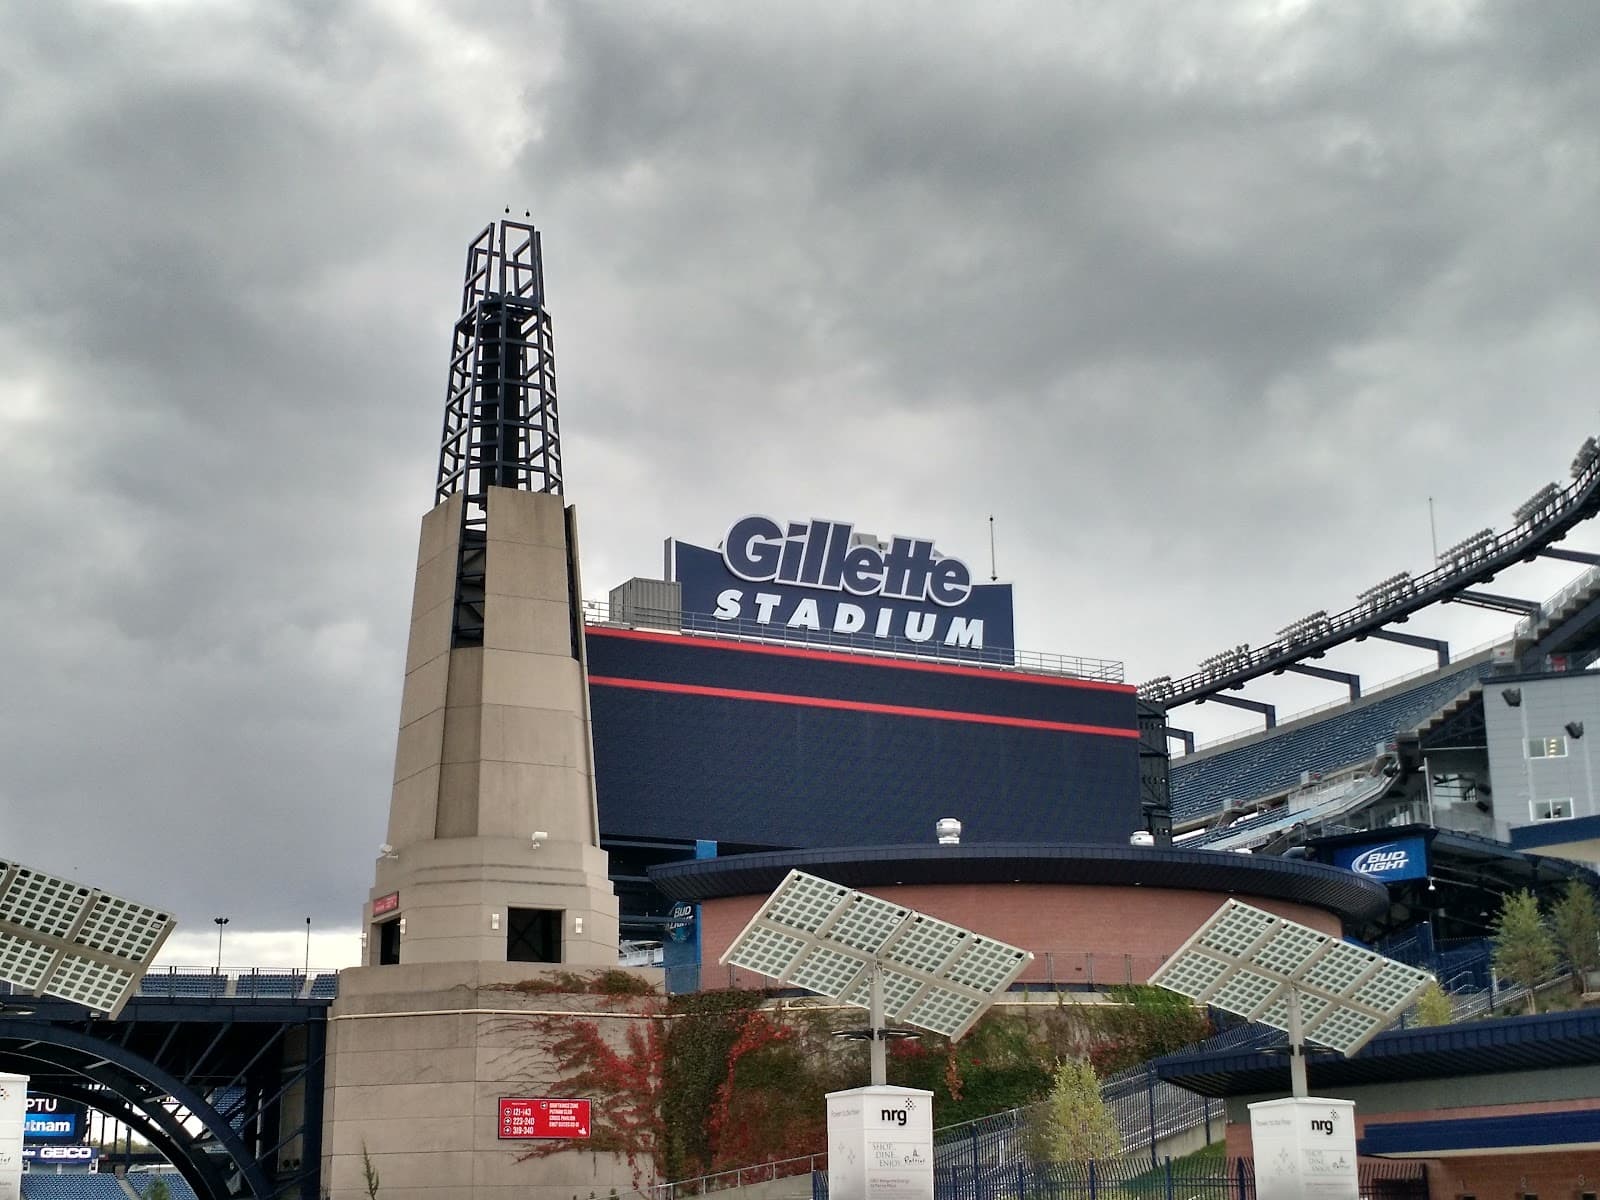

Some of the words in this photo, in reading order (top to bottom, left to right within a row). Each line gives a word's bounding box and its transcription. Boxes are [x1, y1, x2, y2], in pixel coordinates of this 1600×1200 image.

[722, 513, 973, 607] Gillette
[712, 589, 984, 649] STADIUM
[1367, 851, 1406, 864] BUD
[1360, 859, 1409, 873] LIGHT
[674, 906, 692, 918] BUD
[881, 1109, 907, 1126] nrg
[1311, 1120, 1334, 1135] nrg
[40, 1147, 92, 1159] GEICO
